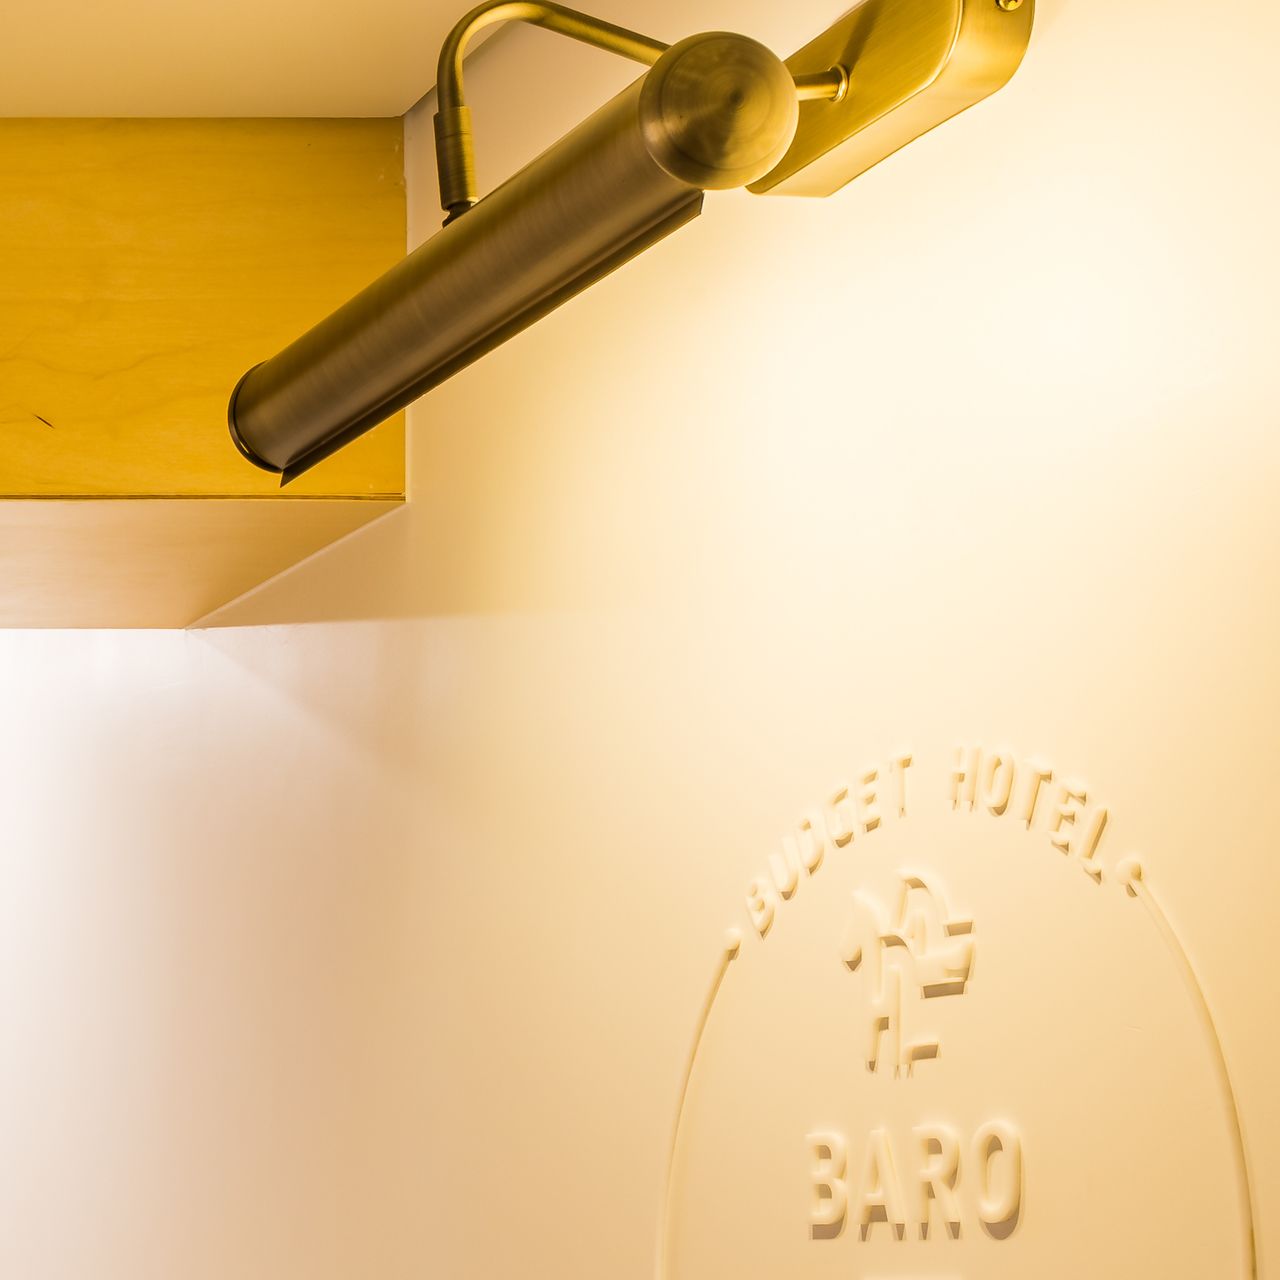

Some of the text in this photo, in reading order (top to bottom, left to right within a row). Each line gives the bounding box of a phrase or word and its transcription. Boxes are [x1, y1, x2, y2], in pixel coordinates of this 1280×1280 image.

[744, 744, 1110, 936] BUDGET HOTEL
[806, 1120, 1026, 1240] BARO
